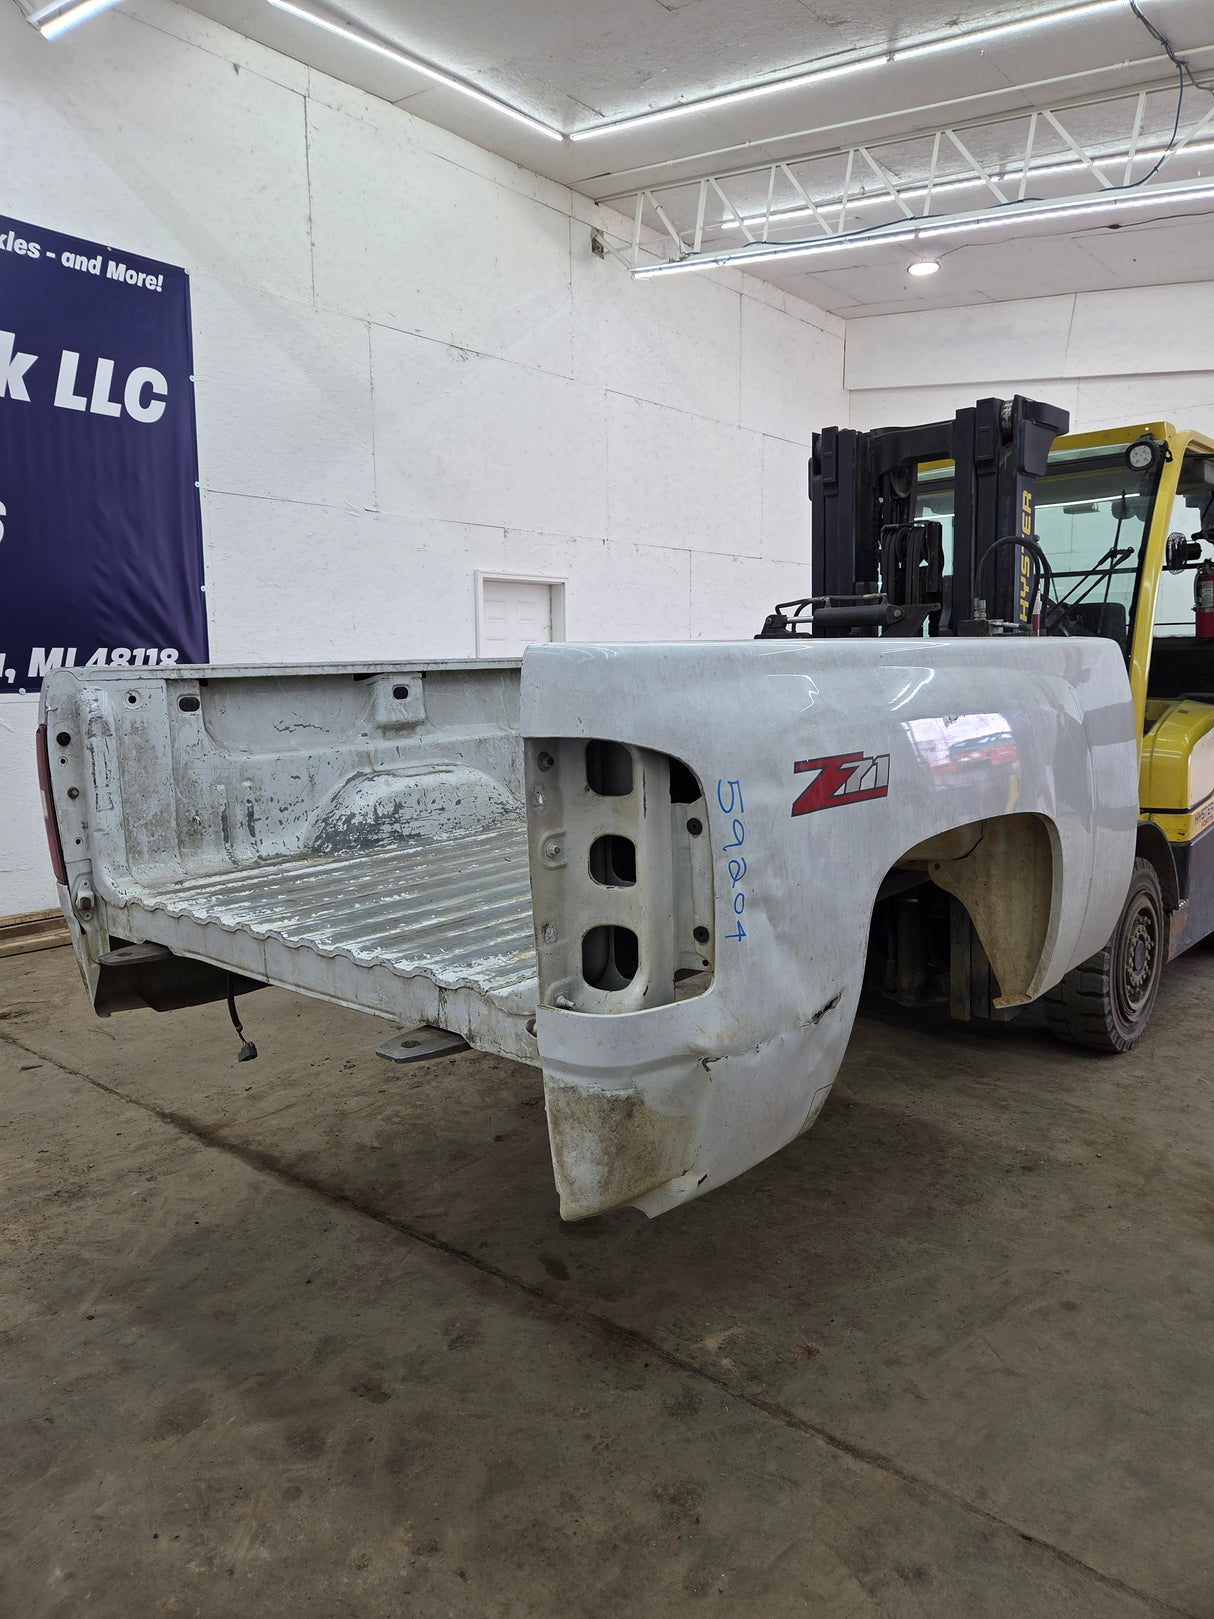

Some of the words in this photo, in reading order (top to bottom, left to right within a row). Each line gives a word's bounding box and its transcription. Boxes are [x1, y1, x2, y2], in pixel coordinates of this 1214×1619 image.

[61, 251, 102, 275] and
[106, 260, 164, 292] More!
[53, 349, 168, 423] LLC
[1019, 490, 1032, 622] HYSER
[85, 647, 179, 667] 48118
[791, 751, 890, 817] Z71
